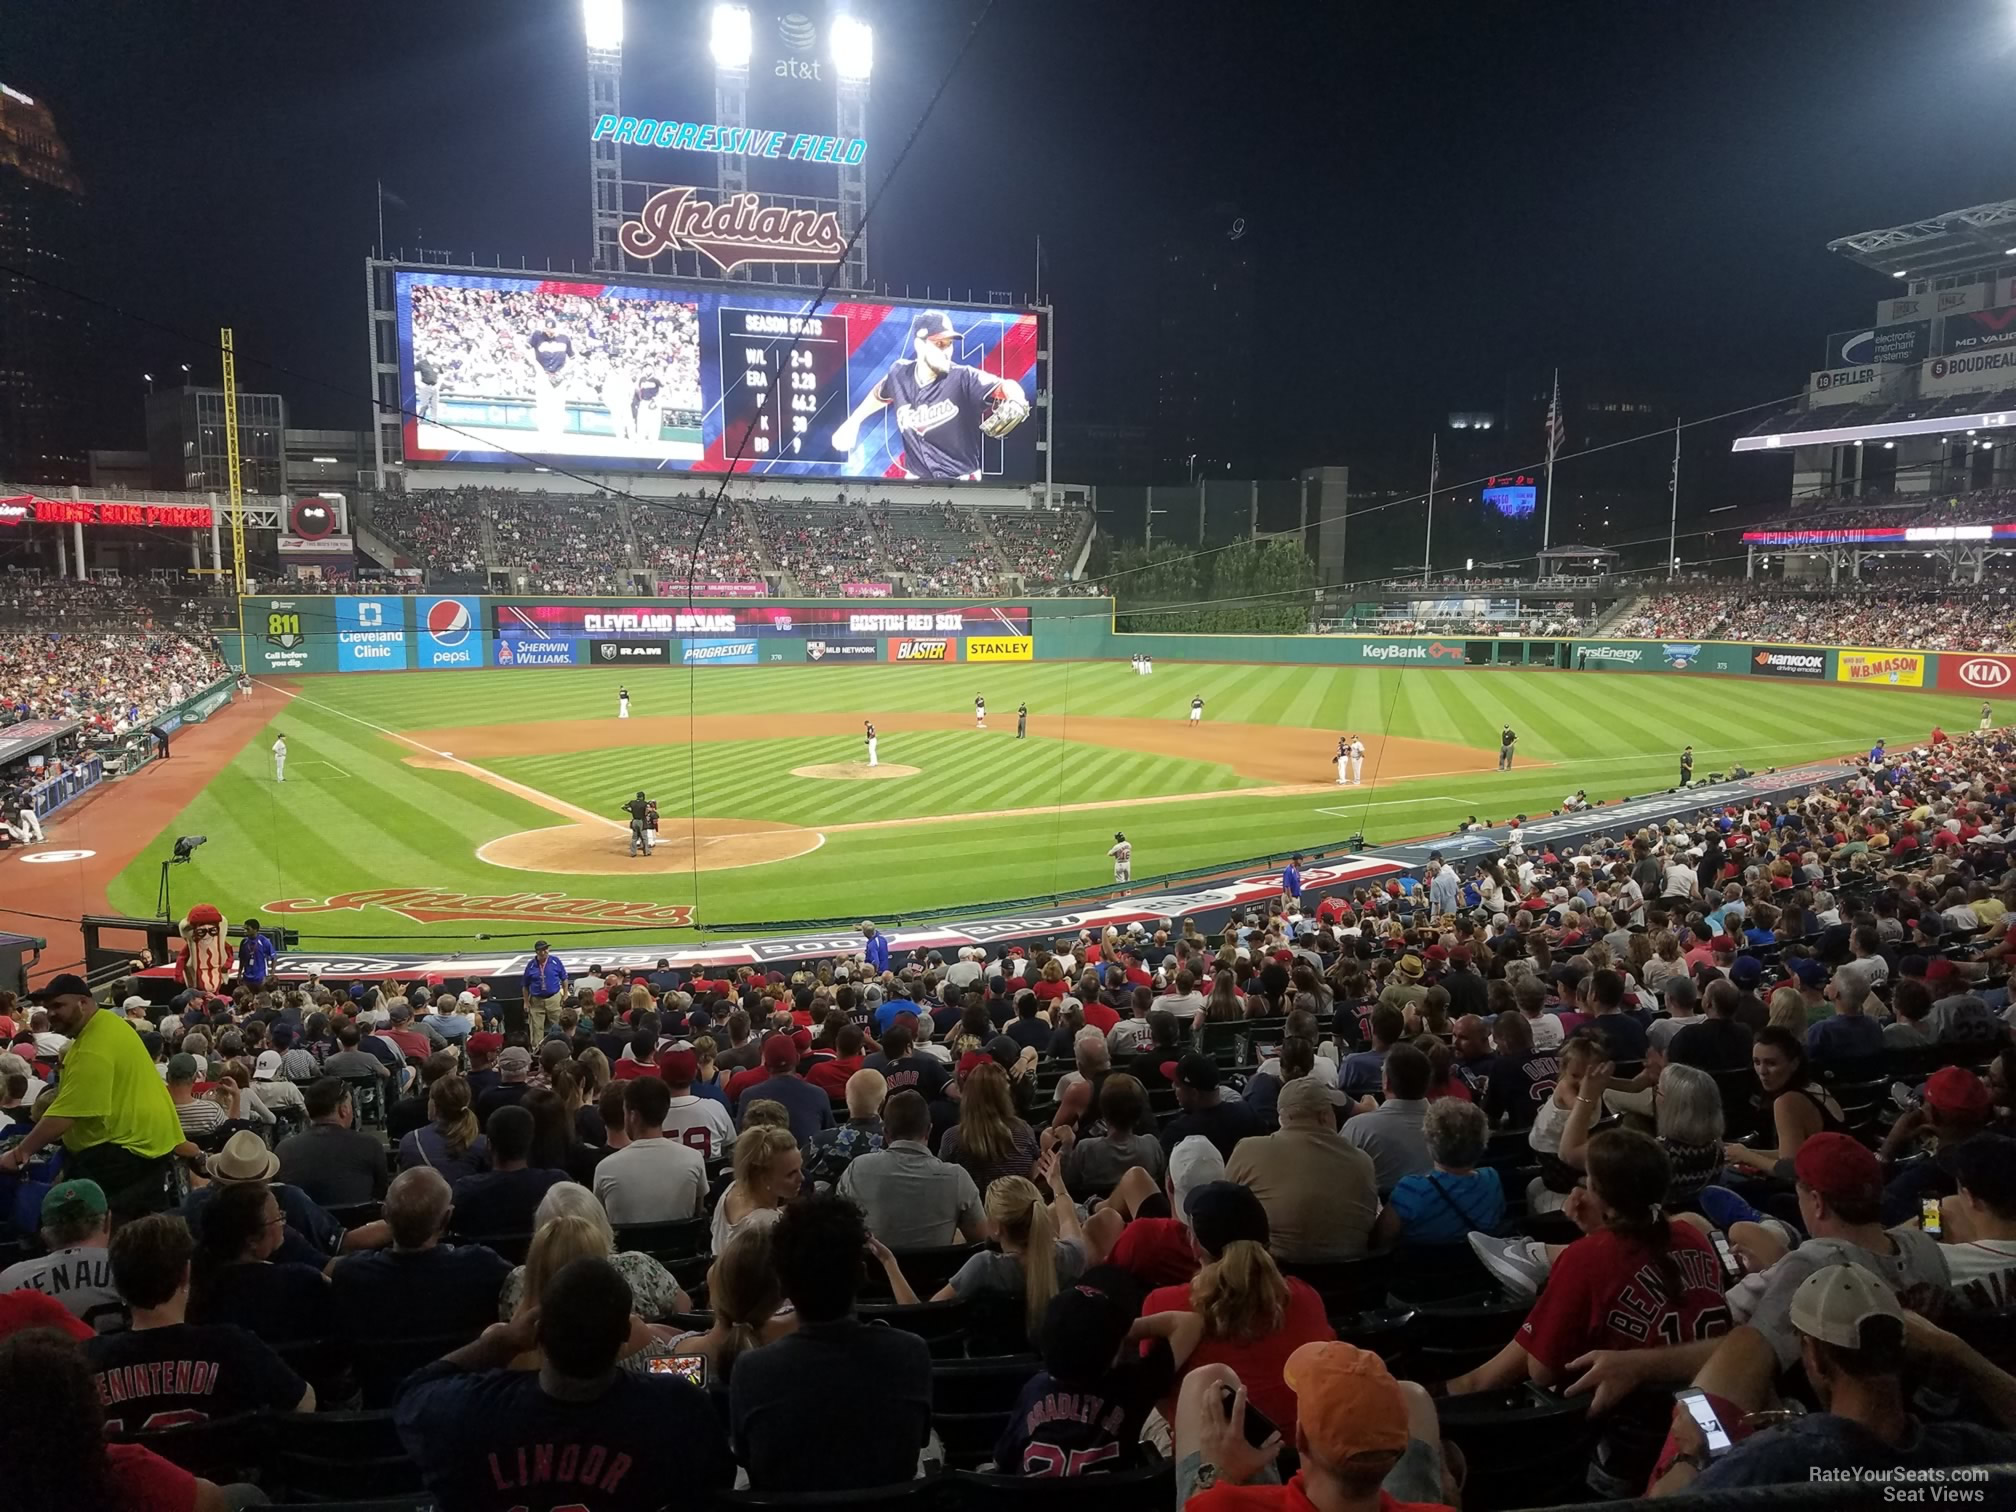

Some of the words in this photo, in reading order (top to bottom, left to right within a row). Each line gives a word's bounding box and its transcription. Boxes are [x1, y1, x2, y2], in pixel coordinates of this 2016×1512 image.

[774, 57, 822, 82] at&t
[591, 114, 786, 159] PROGRESSIVE
[787, 132, 868, 166] FIELD
[618, 187, 849, 264] Indians
[745, 314, 788, 333] SEASON
[789, 317, 823, 336] STATS
[1875, 330, 1916, 344] electronic
[1874, 340, 1914, 353] merchant
[745, 348, 768, 365] W/L
[1873, 351, 1910, 363] systems
[746, 370, 768, 387] ERA
[1819, 375, 1829, 386] 19
[1832, 368, 1874, 386] FELLER
[760, 415, 770, 431] K
[754, 437, 770, 452] BB
[793, 437, 801, 454] 9
[36, 502, 95, 522] HOME
[100, 504, 143, 524] RUN
[146, 507, 212, 528] PORCH
[268, 613, 300, 635] 811
[585, 614, 672, 632] CLEVELAND
[675, 614, 736, 632] INDIANS
[849, 615, 905, 632] BOSTON
[906, 615, 933, 631] RED
[935, 614, 963, 631] SOX
[339, 629, 403, 643] Cleveland
[354, 645, 391, 658] Clinic
[517, 641, 569, 653] SHERWIN
[620, 647, 662, 655] RAM
[684, 643, 756, 659] PROGRESSIVE
[895, 640, 946, 660] BLASTER
[971, 643, 1028, 655] STANLEY
[1362, 644, 1427, 660] KeyBank
[265, 652, 280, 660] Call
[281, 652, 308, 660] before
[271, 660, 286, 668] you
[287, 659, 303, 668] dig.
[433, 650, 471, 665] pepsi
[1777, 665, 1796, 673] driving
[1967, 665, 2003, 682] KIA
[260, 886, 697, 928] Indians
[1132, 894, 1223, 911] 2013
[761, 939, 862, 955] 200
[850, 1014, 869, 1025] LLER
[1132, 1029, 1152, 1042] FELL
[886, 1070, 920, 1090] NDOR
[16, 1260, 111, 1295] ENAU
[94, 1360, 220, 1406] ENINTENDI
[487, 1443, 633, 1495] LINDOR
